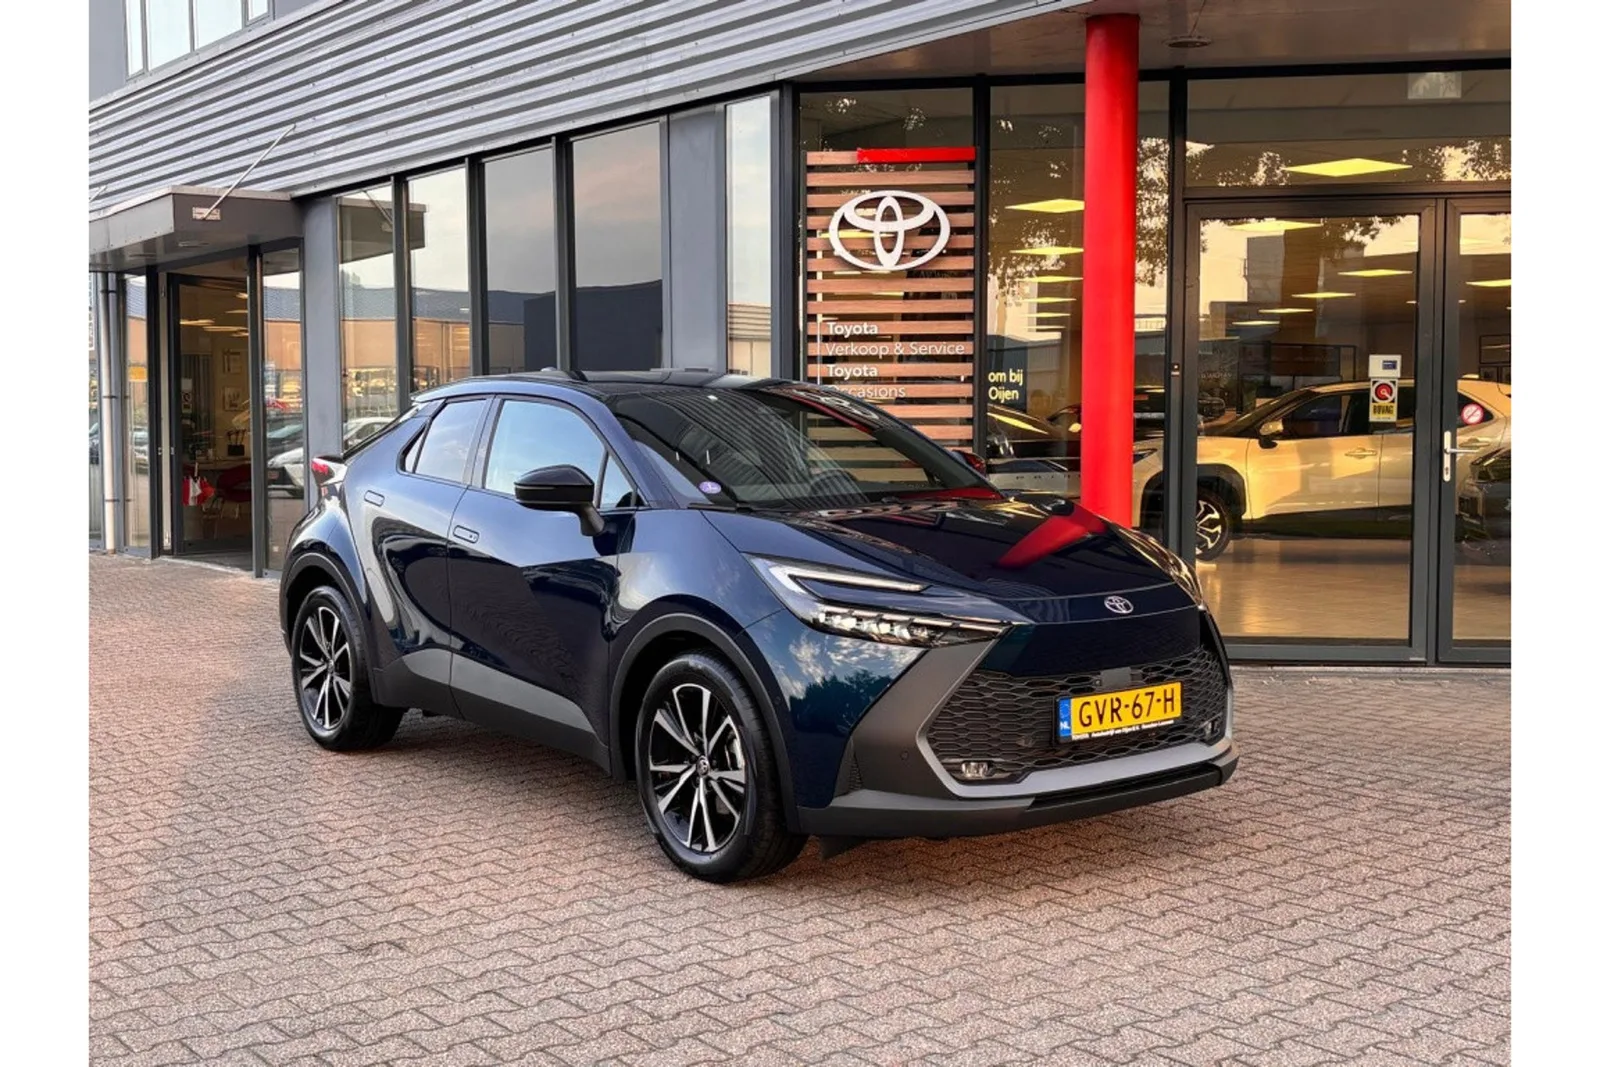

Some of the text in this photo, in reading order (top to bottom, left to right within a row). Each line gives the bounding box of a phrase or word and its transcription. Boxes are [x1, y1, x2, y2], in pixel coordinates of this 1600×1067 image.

[827, 322, 878, 338] Toyota
[825, 341, 965, 359] Verkoop & Service
[827, 365, 878, 380] Toyota
[1009, 368, 1023, 386] bij
[988, 386, 1019, 403] Oijen
[1078, 687, 1175, 728] GVR-67-H
[1060, 721, 1071, 730] NL
